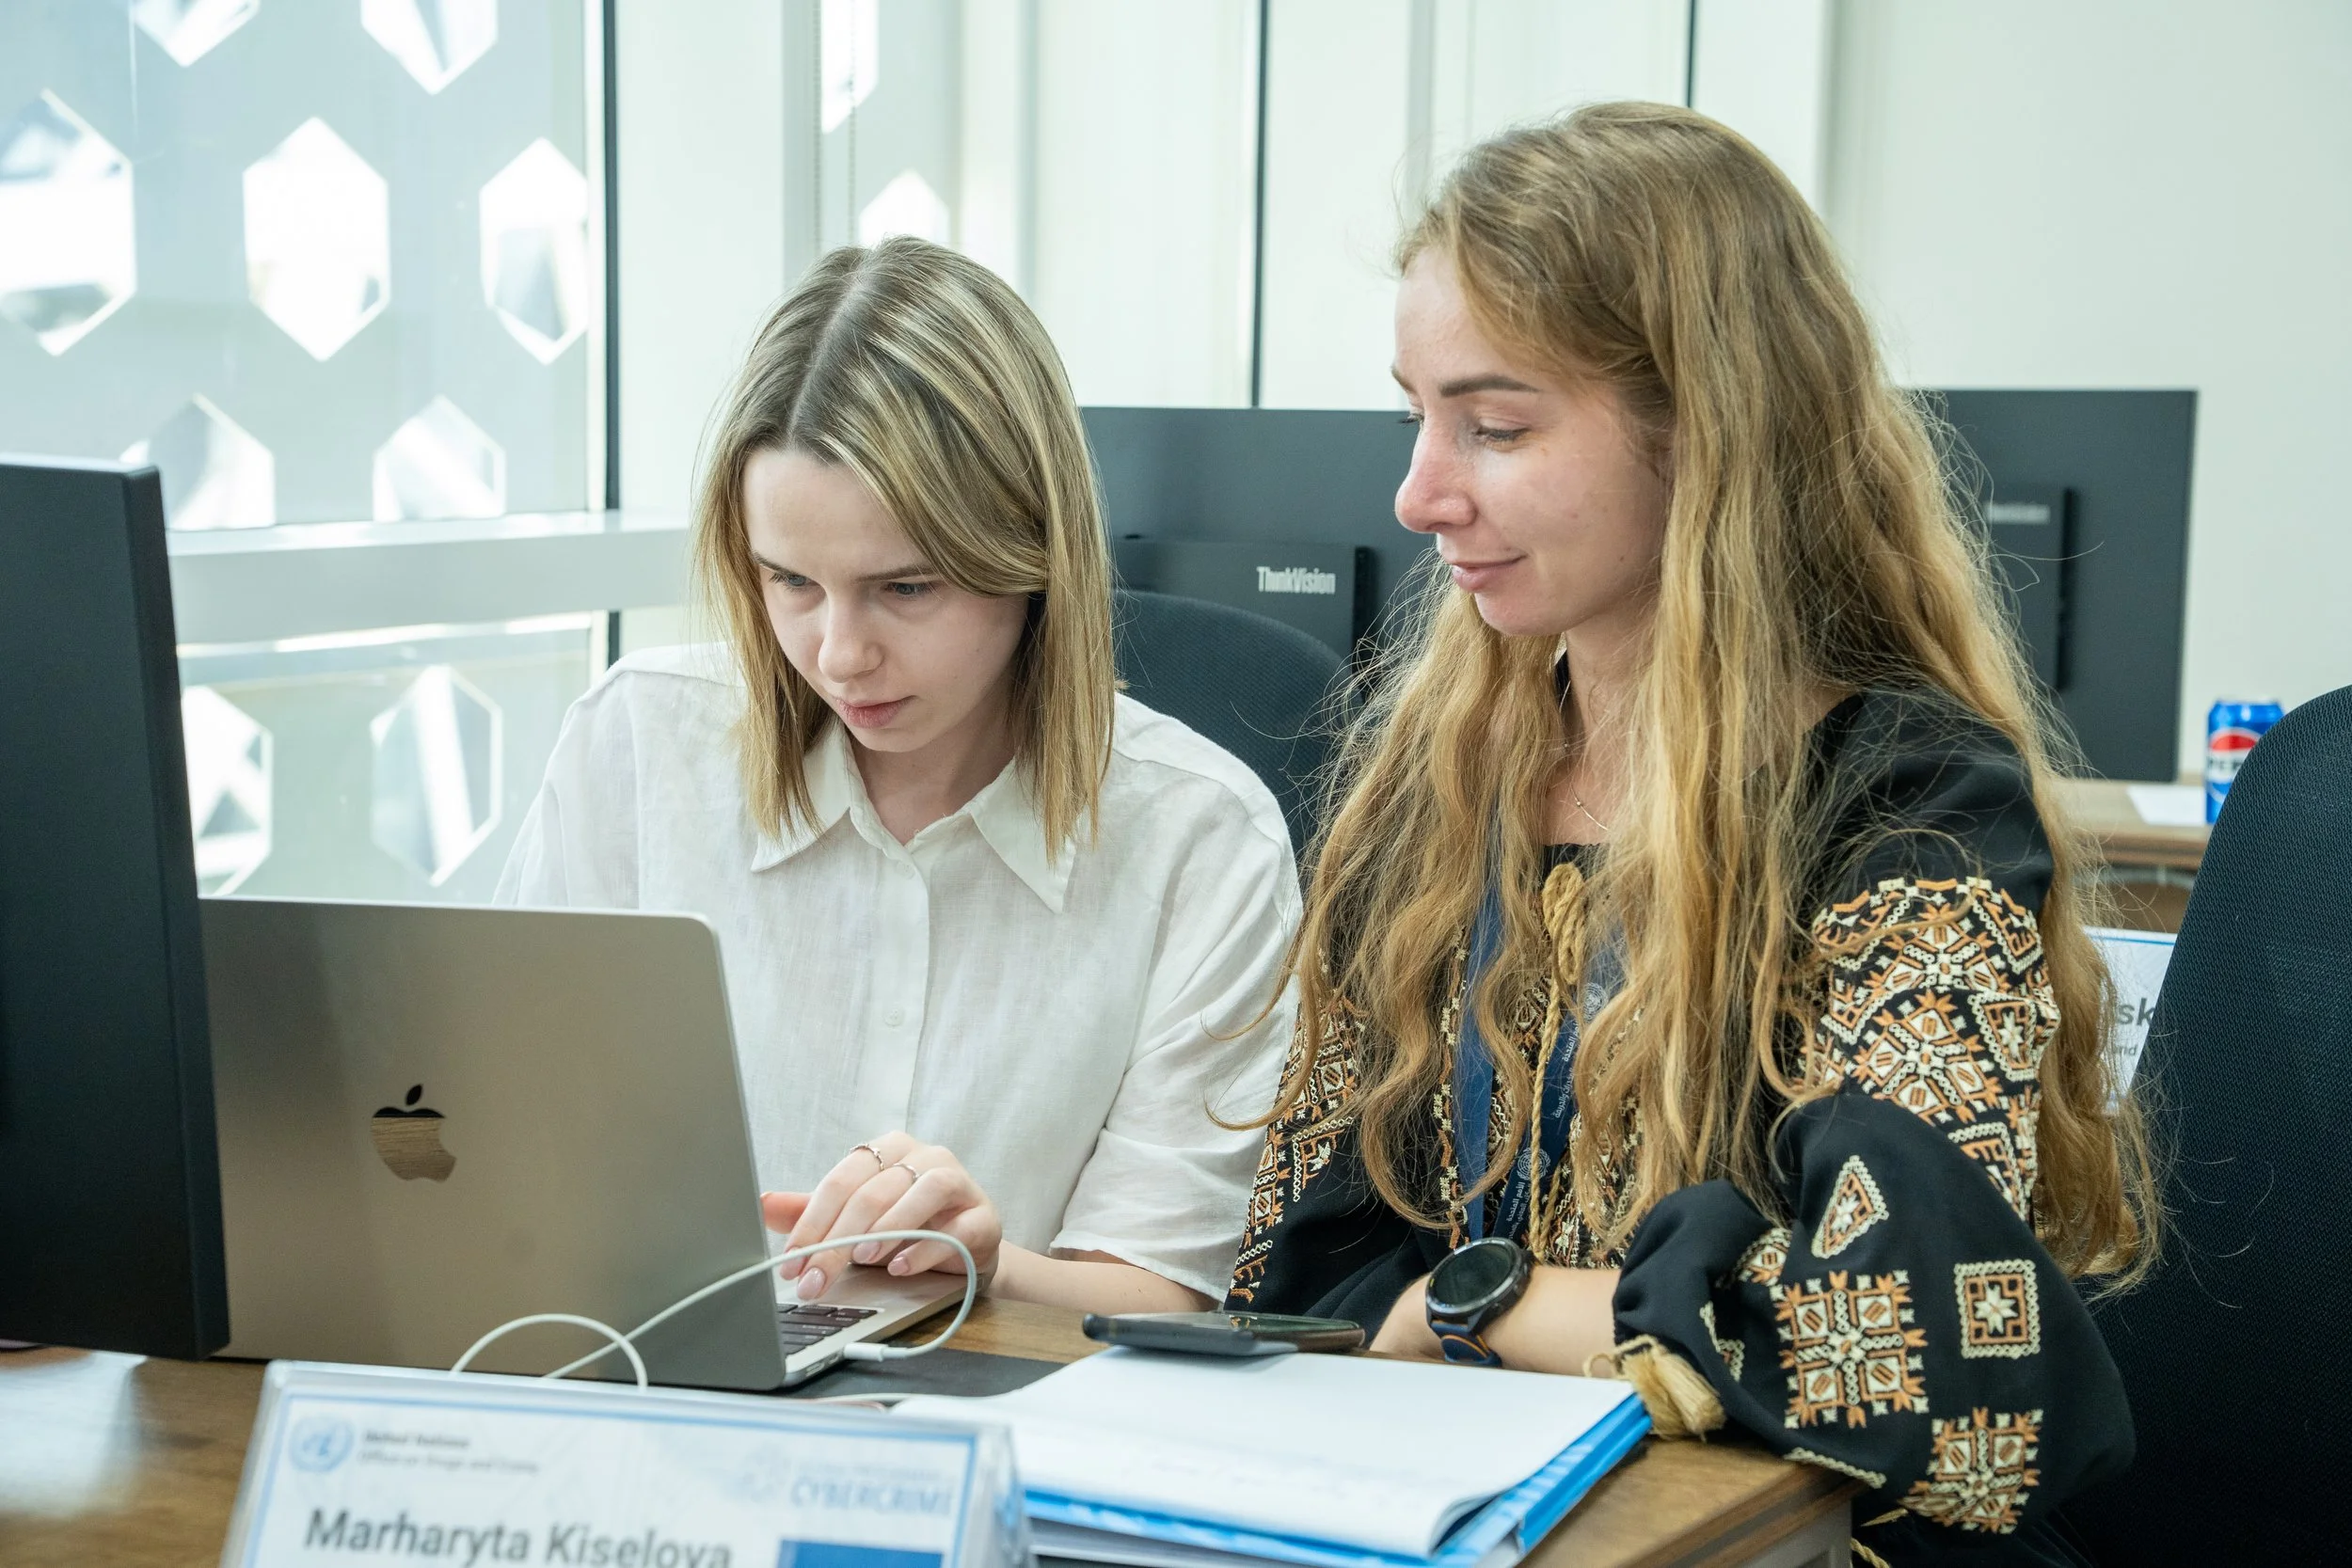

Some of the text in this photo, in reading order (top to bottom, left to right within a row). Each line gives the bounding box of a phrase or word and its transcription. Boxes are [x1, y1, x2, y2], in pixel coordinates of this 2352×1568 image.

[1257, 566, 1336, 594] ThinkVision
[305, 1506, 732, 1568] Marharyta Kiselova
